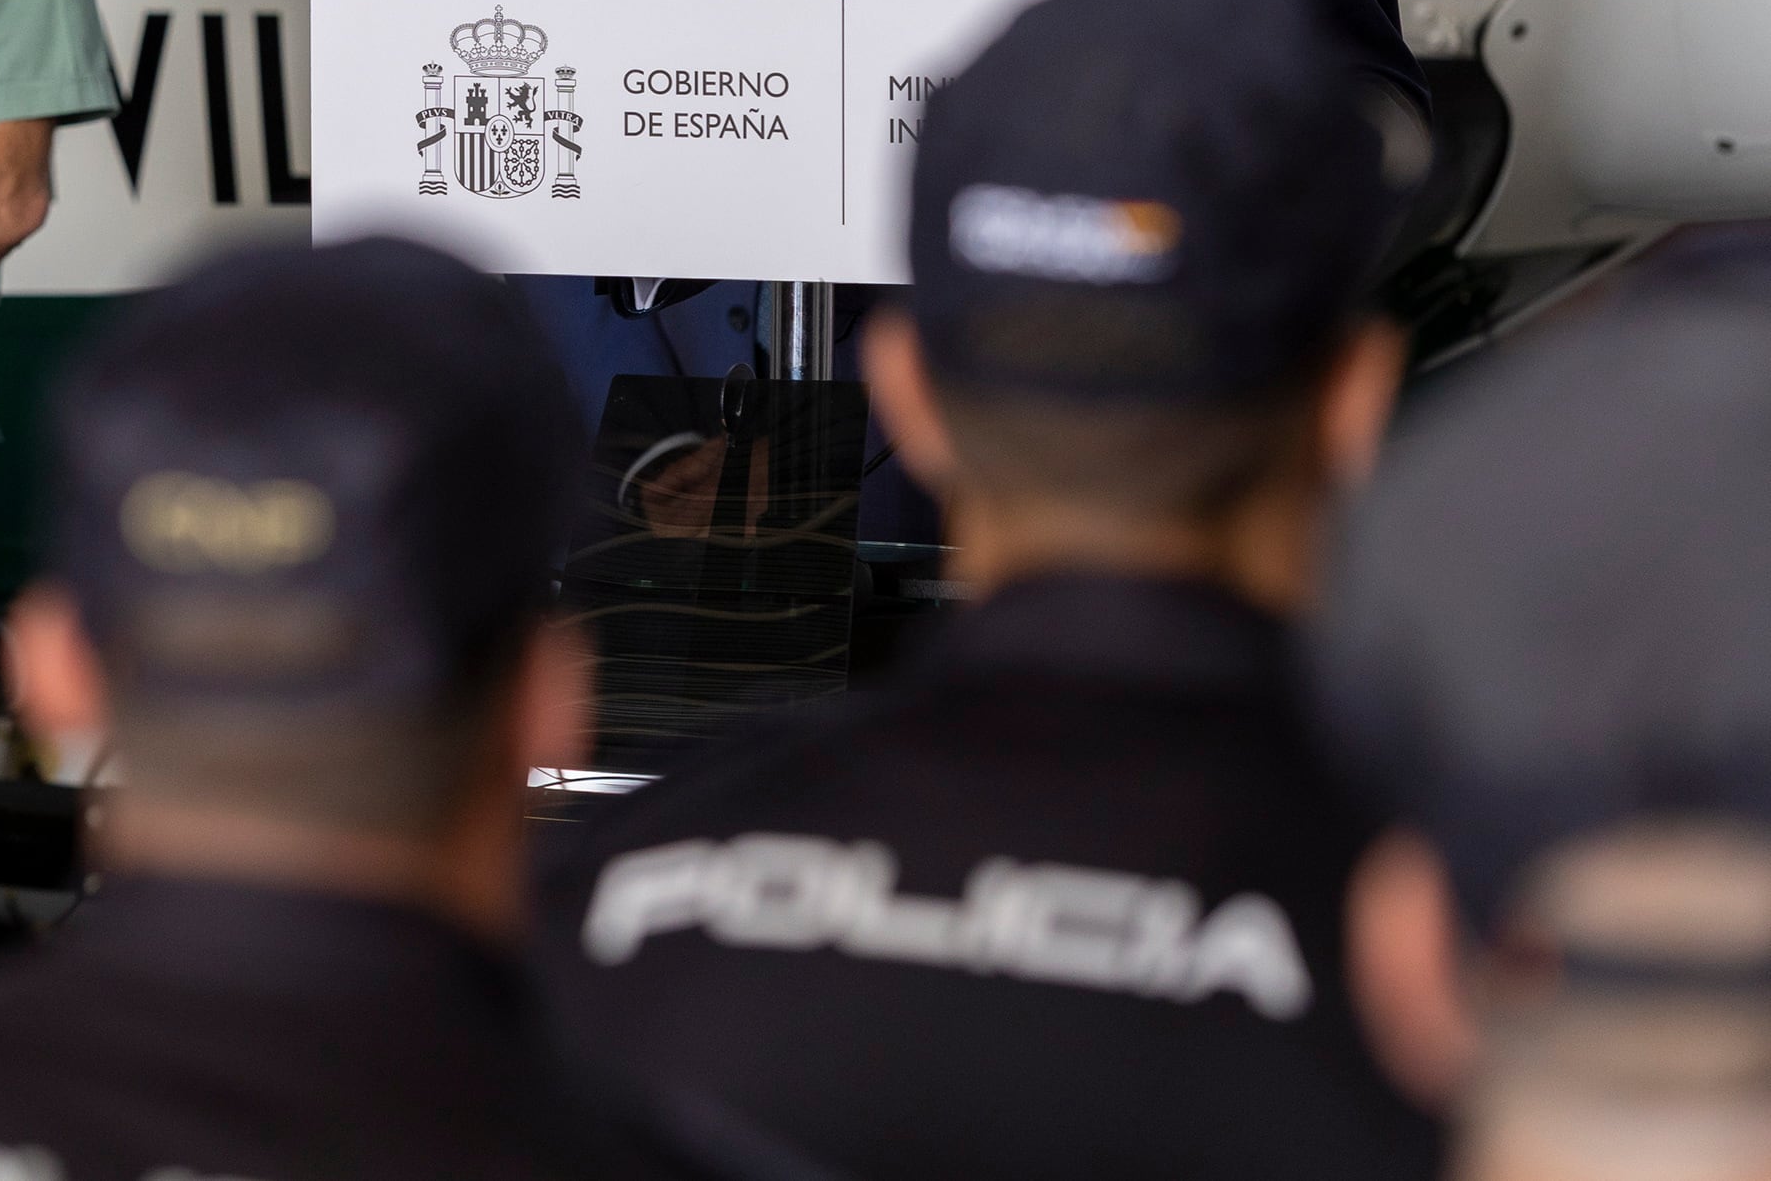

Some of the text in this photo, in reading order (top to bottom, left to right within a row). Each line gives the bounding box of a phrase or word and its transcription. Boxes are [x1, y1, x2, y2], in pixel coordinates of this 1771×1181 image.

[623, 69, 789, 98] GOBIERNO
[421, 108, 448, 119] PLVS
[547, 111, 579, 125] VLTRA
[624, 108, 789, 140] DE ESPAÑA
